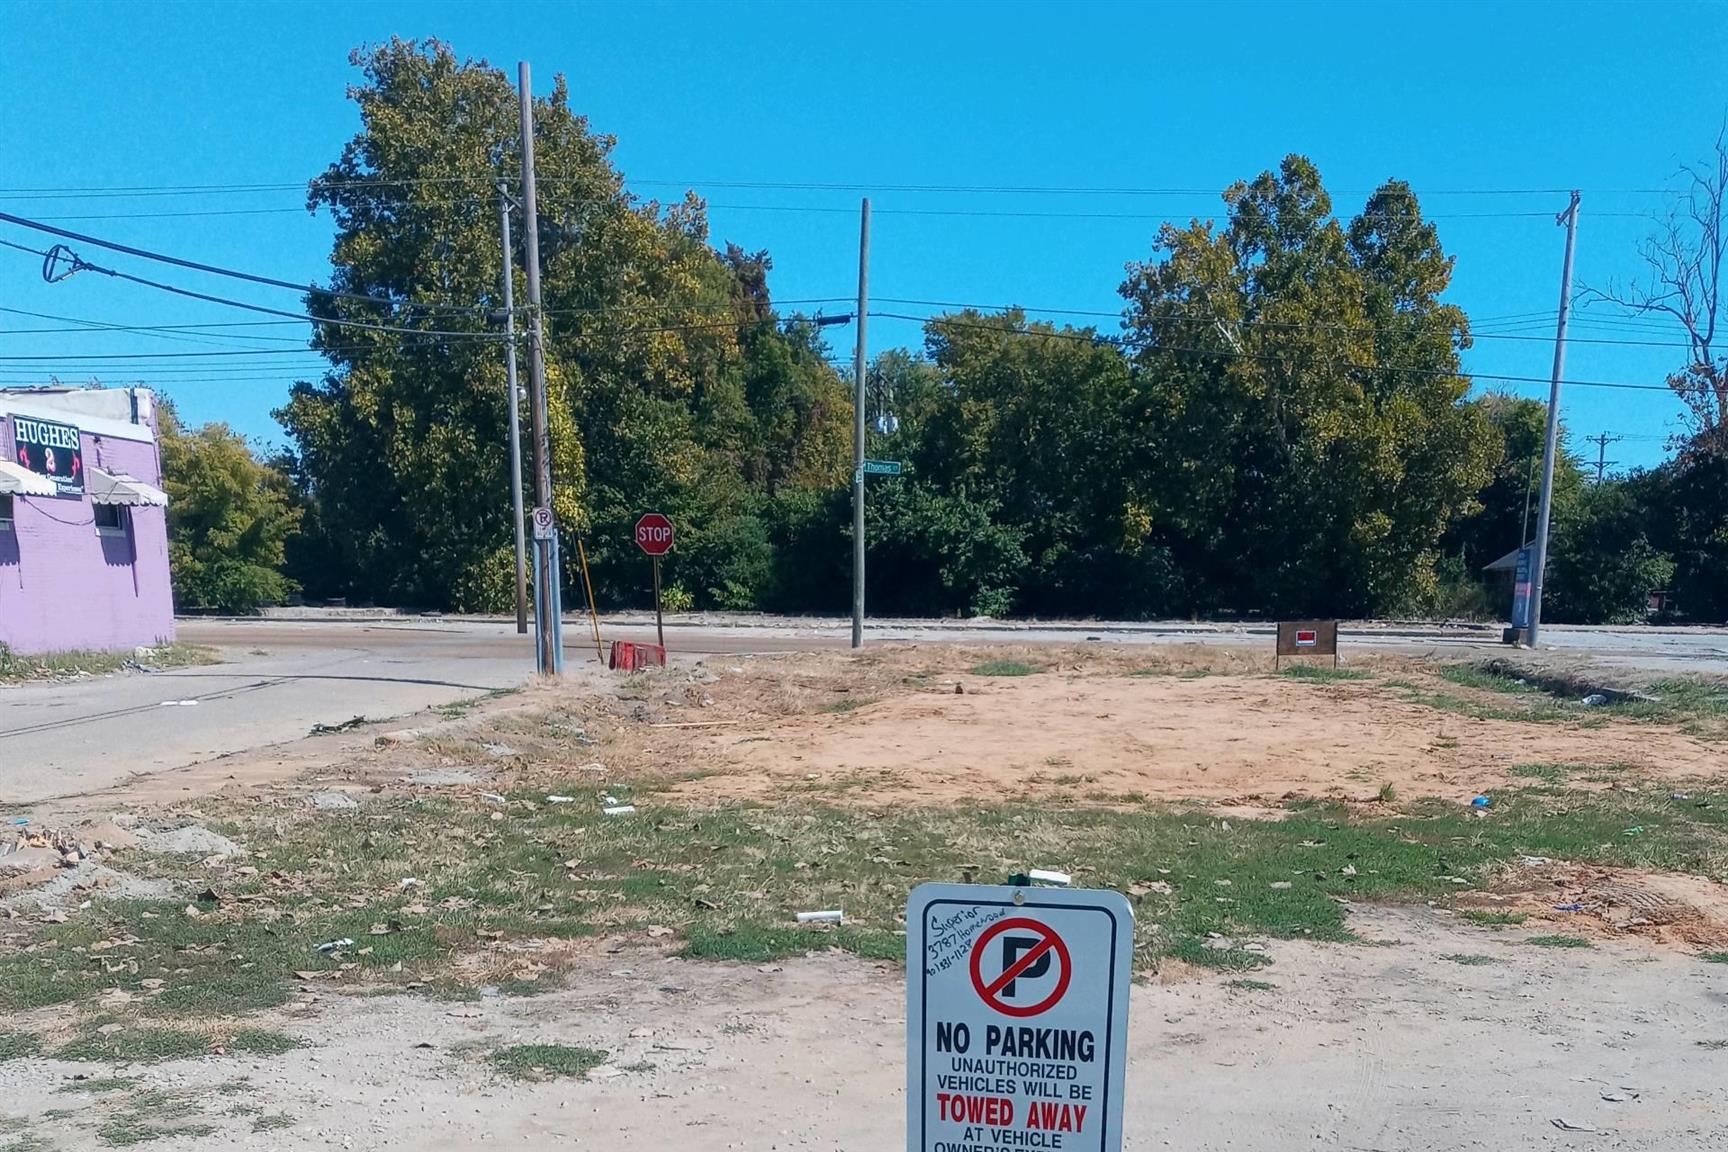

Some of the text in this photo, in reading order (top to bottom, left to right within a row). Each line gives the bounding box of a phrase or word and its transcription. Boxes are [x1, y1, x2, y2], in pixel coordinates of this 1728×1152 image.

[14, 419, 79, 450] HUGHES
[639, 527, 670, 542] STOP
[931, 906, 980, 938] Superior
[928, 933, 957, 960] 3787
[936, 1021, 1095, 1062] NO PARKING
[951, 1057, 1077, 1080] UNAUTHORIZED
[937, 1074, 1092, 1100] VEHICLES WILL BE
[936, 1093, 1087, 1133] TOWED AWAY
[963, 1127, 1062, 1149] AT VEHICLE
